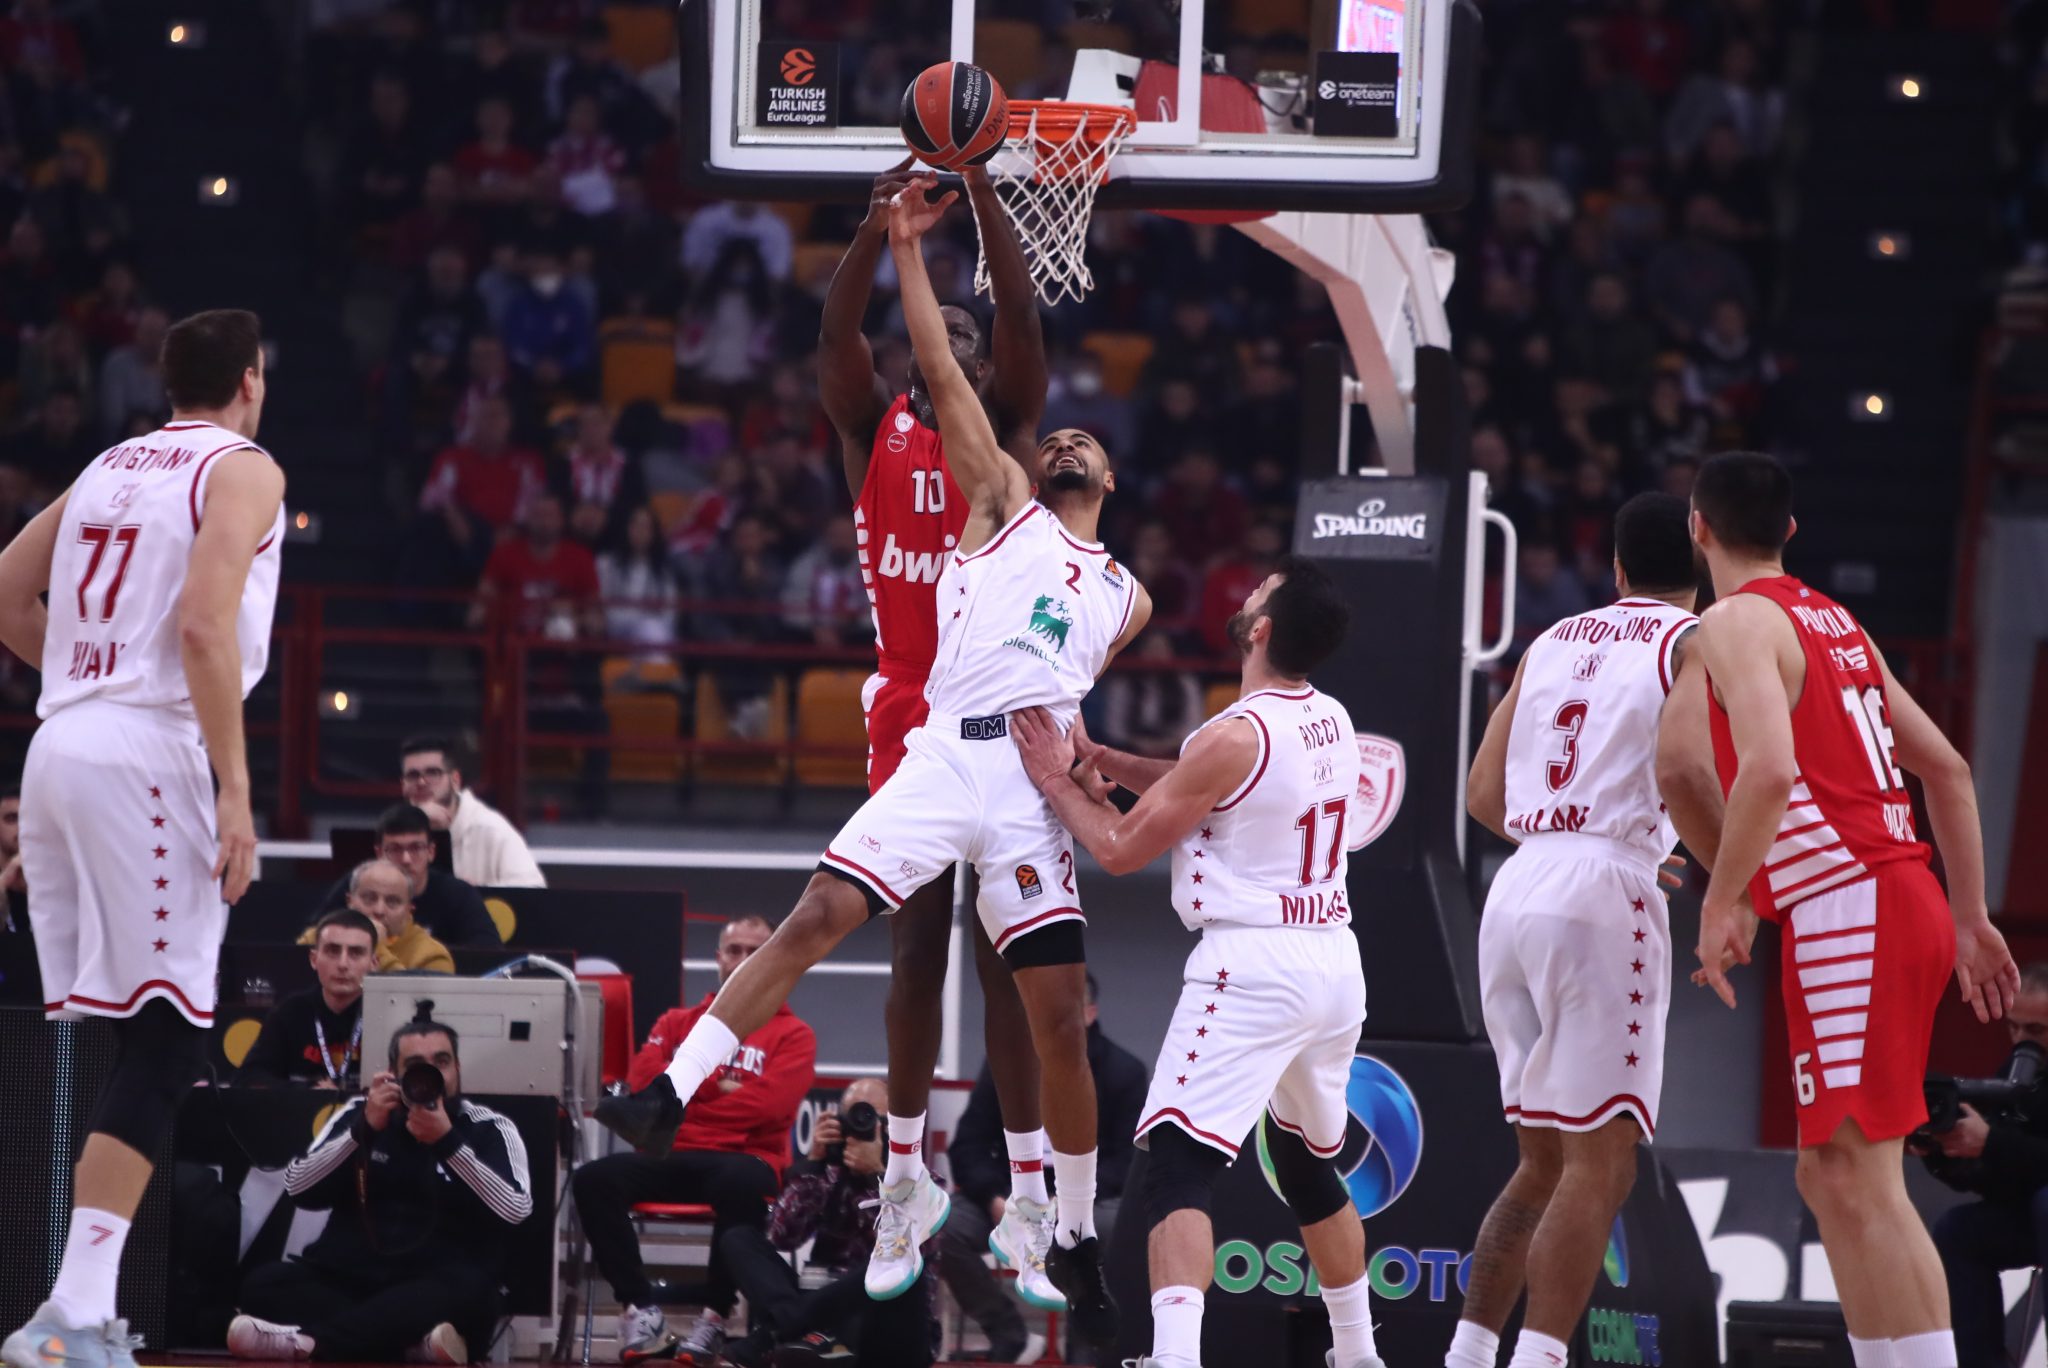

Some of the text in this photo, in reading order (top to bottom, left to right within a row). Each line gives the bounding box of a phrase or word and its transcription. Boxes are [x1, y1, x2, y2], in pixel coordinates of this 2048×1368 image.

[768, 100, 826, 112] AIRLINES
[769, 87, 826, 99] TURKISH
[1338, 88, 1395, 100] oneteam
[767, 112, 826, 125] EuroLeague
[911, 468, 945, 514] 10
[1312, 512, 1427, 540] SPALDING
[77, 522, 142, 623] 77
[878, 533, 956, 584] bwi
[1065, 561, 1082, 595] 2
[1298, 715, 1341, 751] RICCI
[1546, 699, 1590, 794] 3
[1294, 795, 1349, 889] 17
[1058, 850, 1075, 896] 2
[1793, 1052, 1816, 1107] 6
